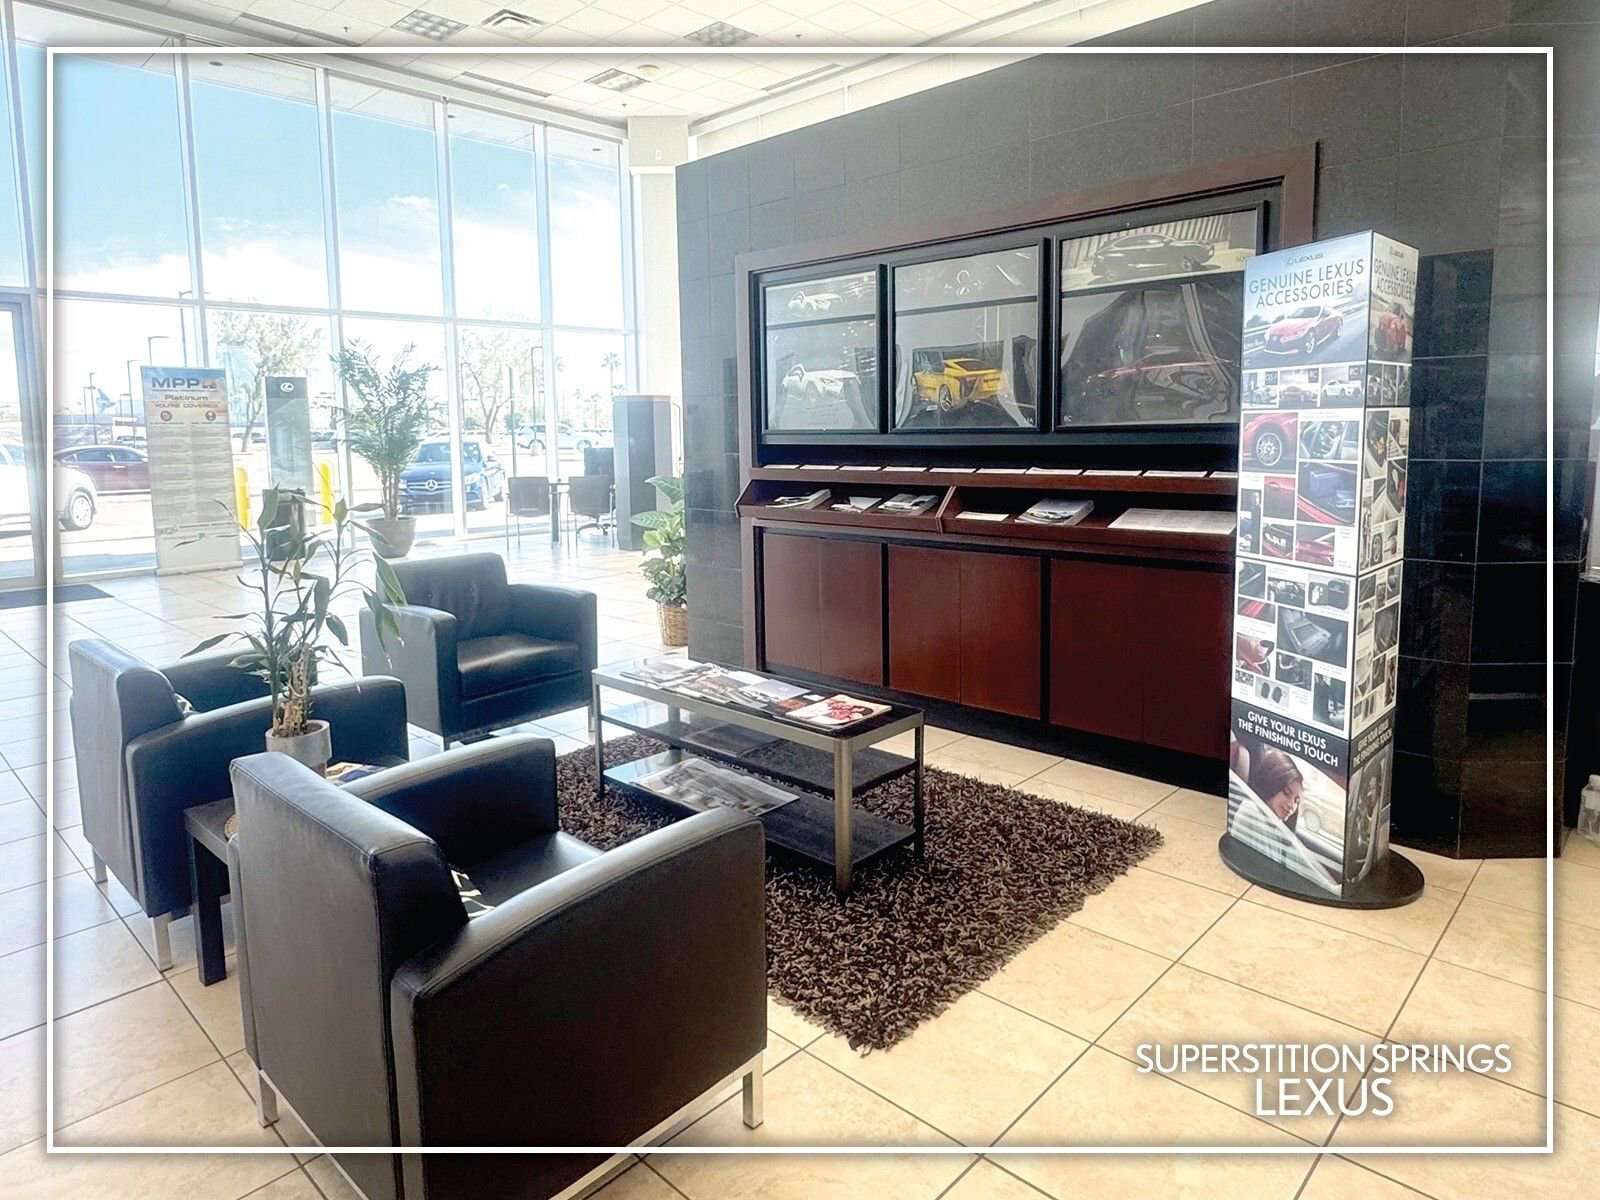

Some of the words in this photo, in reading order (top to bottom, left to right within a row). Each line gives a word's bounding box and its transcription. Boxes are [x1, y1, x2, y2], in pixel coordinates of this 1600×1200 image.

[1295, 252, 1324, 264] LEXUS
[1373, 258, 1400, 281] GENUINE
[1249, 268, 1313, 294] GENUINE
[1318, 259, 1365, 282] LEXUS
[1375, 277, 1413, 300] ACCESSORIES
[1255, 278, 1354, 309] ACCESSORIES
[151, 377, 200, 388] MPP
[1237, 718, 1253, 733] THE
[1255, 725, 1302, 752] FINISHING
[1303, 745, 1339, 768] TOUCH
[1247, 711, 1268, 727] GIVE
[1269, 717, 1295, 738] YOUR
[1297, 730, 1327, 750] LEXUS
